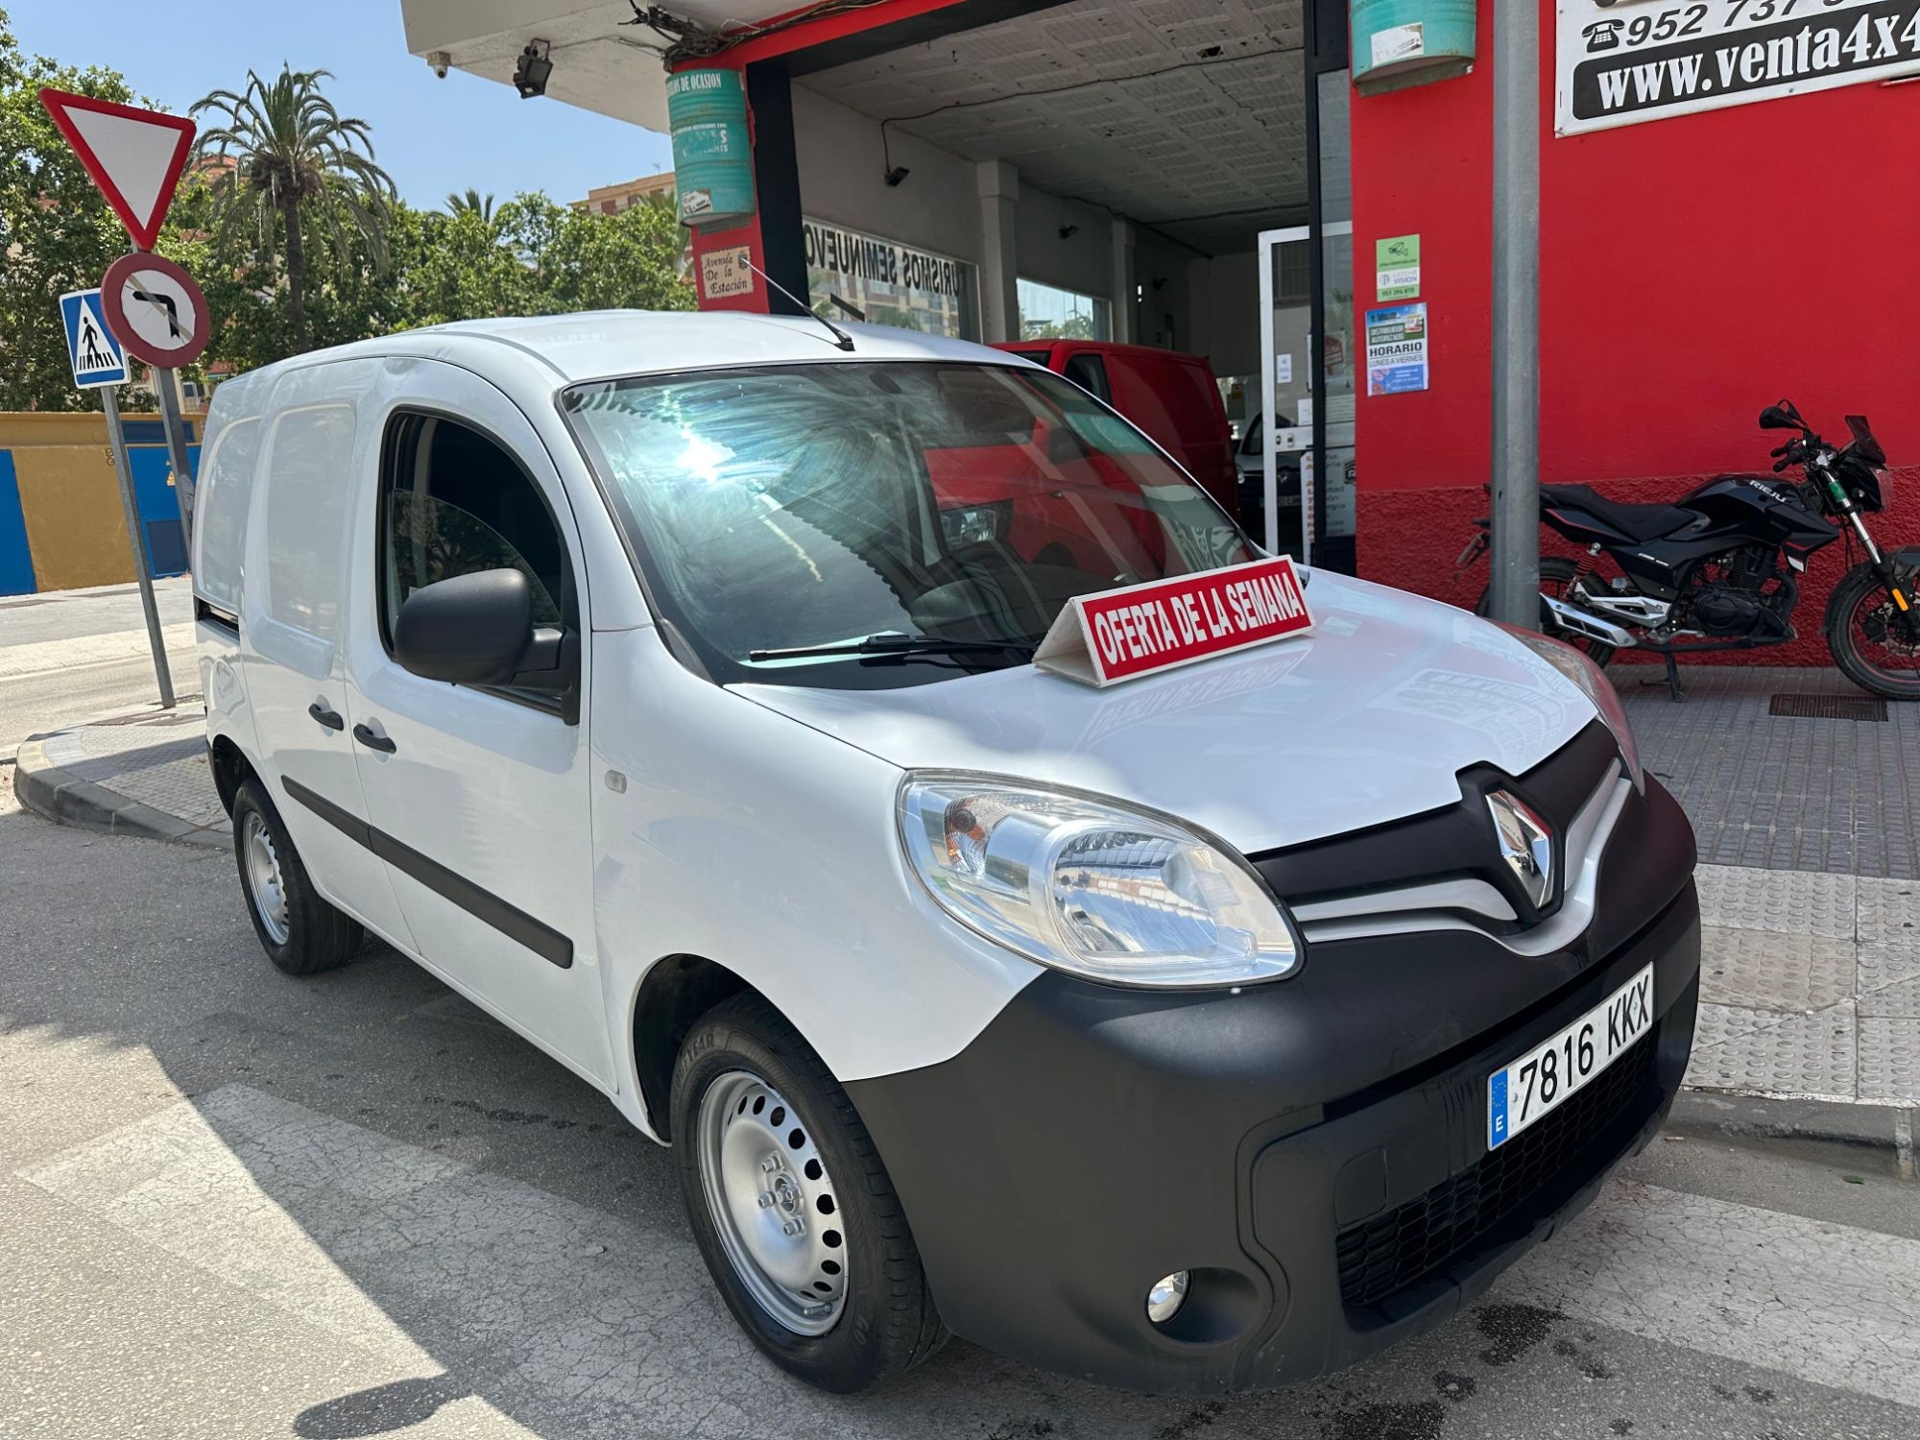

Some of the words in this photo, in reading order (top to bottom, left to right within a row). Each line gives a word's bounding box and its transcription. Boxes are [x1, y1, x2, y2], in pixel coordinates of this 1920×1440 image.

[1626, 4, 1709, 47] 952
[680, 75, 690, 92] DE
[704, 252, 733, 270] Avenida
[705, 269, 718, 281] De
[724, 264, 732, 278] la
[710, 278, 748, 295] Estación
[1369, 342, 1423, 357] HORARIO
[1369, 358, 1388, 368] LUNES
[1395, 354, 1423, 364] VIERNES
[1749, 479, 1787, 503] RIEJU
[1094, 600, 1180, 666] OFERTA
[1172, 592, 1208, 645] DE
[1198, 588, 1234, 638] LA
[1225, 572, 1305, 632] SEMANA
[1496, 1114, 1504, 1133] E
[1519, 1023, 1594, 1122] 7816
[1608, 974, 1649, 1056] KKX
